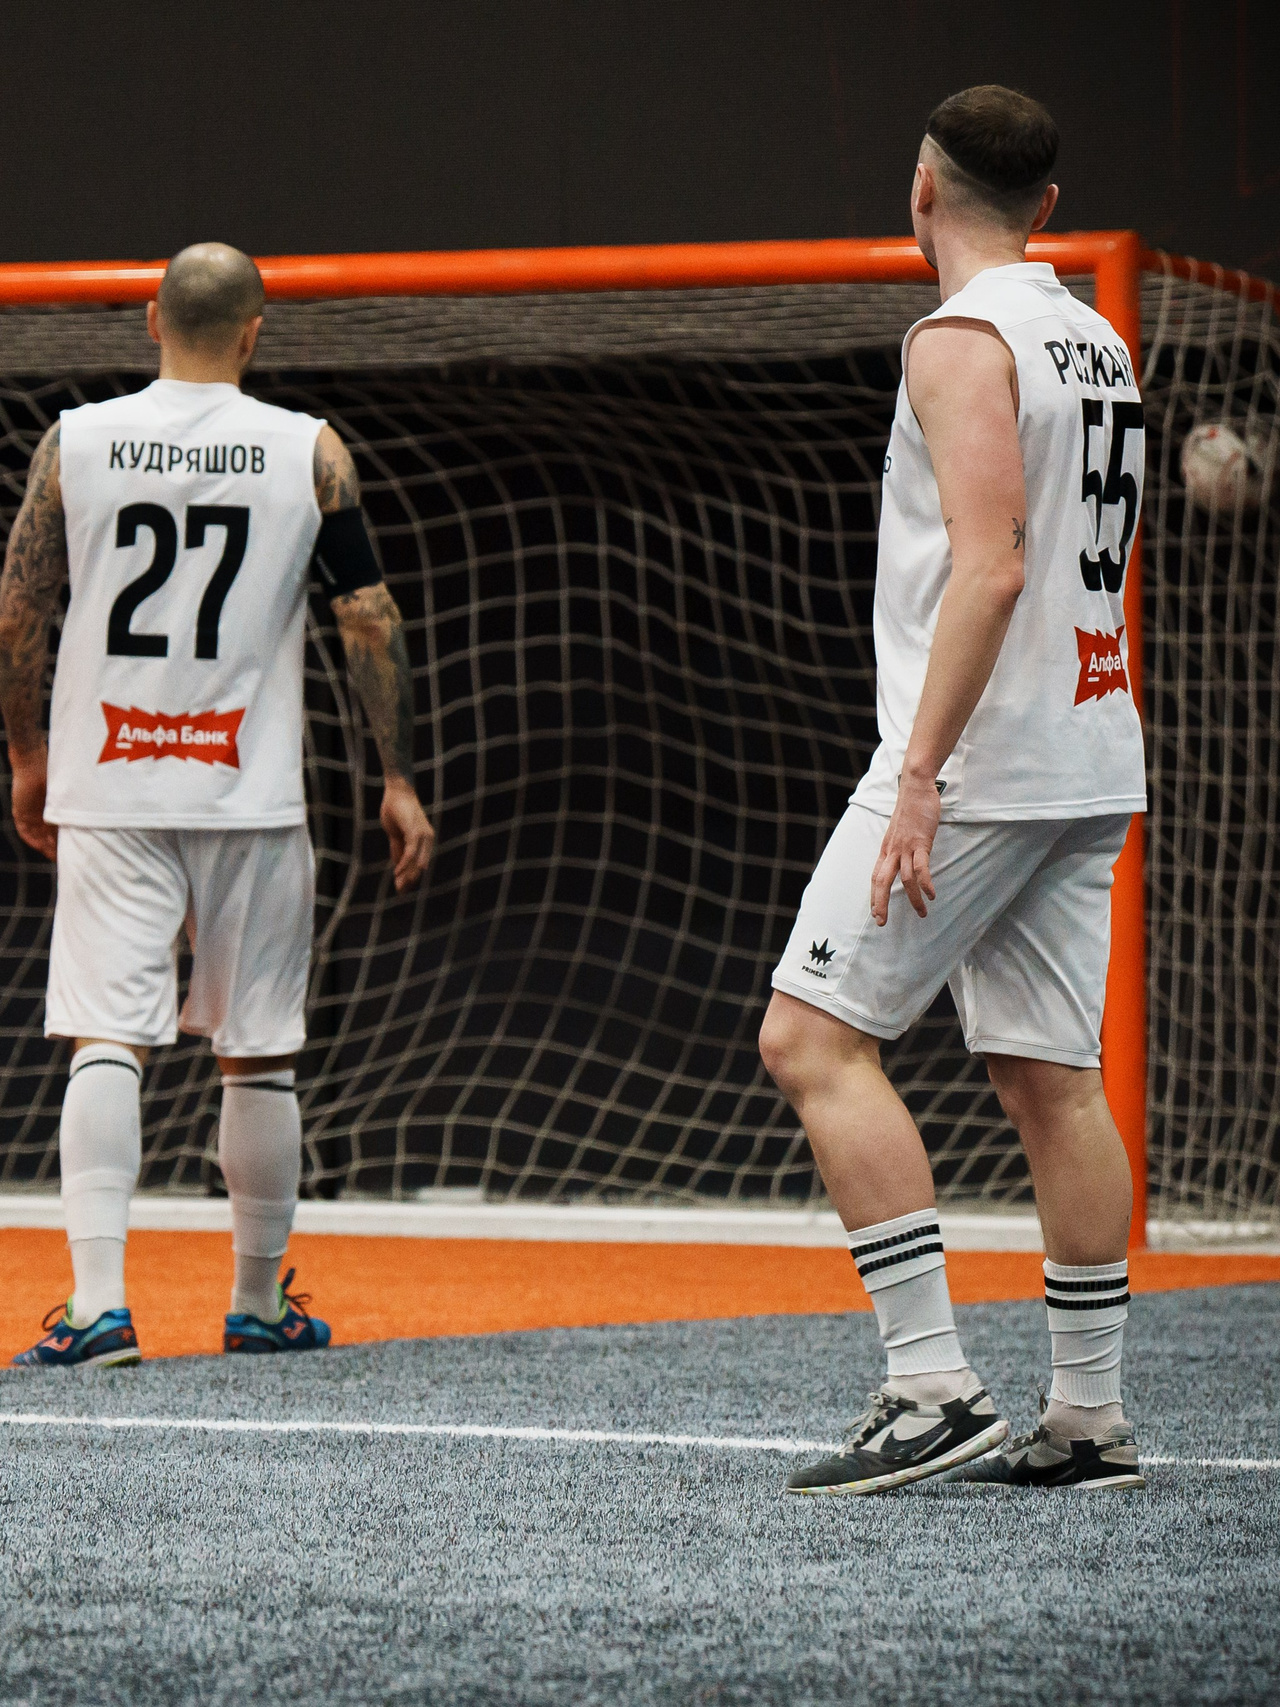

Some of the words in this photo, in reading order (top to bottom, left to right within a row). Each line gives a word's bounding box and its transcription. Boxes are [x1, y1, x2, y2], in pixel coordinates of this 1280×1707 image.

[109, 440, 266, 474] КУДРЯШОВ
[1079, 399, 1145, 593] 55
[106, 501, 251, 661] 27
[115, 722, 178, 749] Альфа
[181, 725, 229, 746] Банк
[801, 965, 827, 980] PRIMERA
